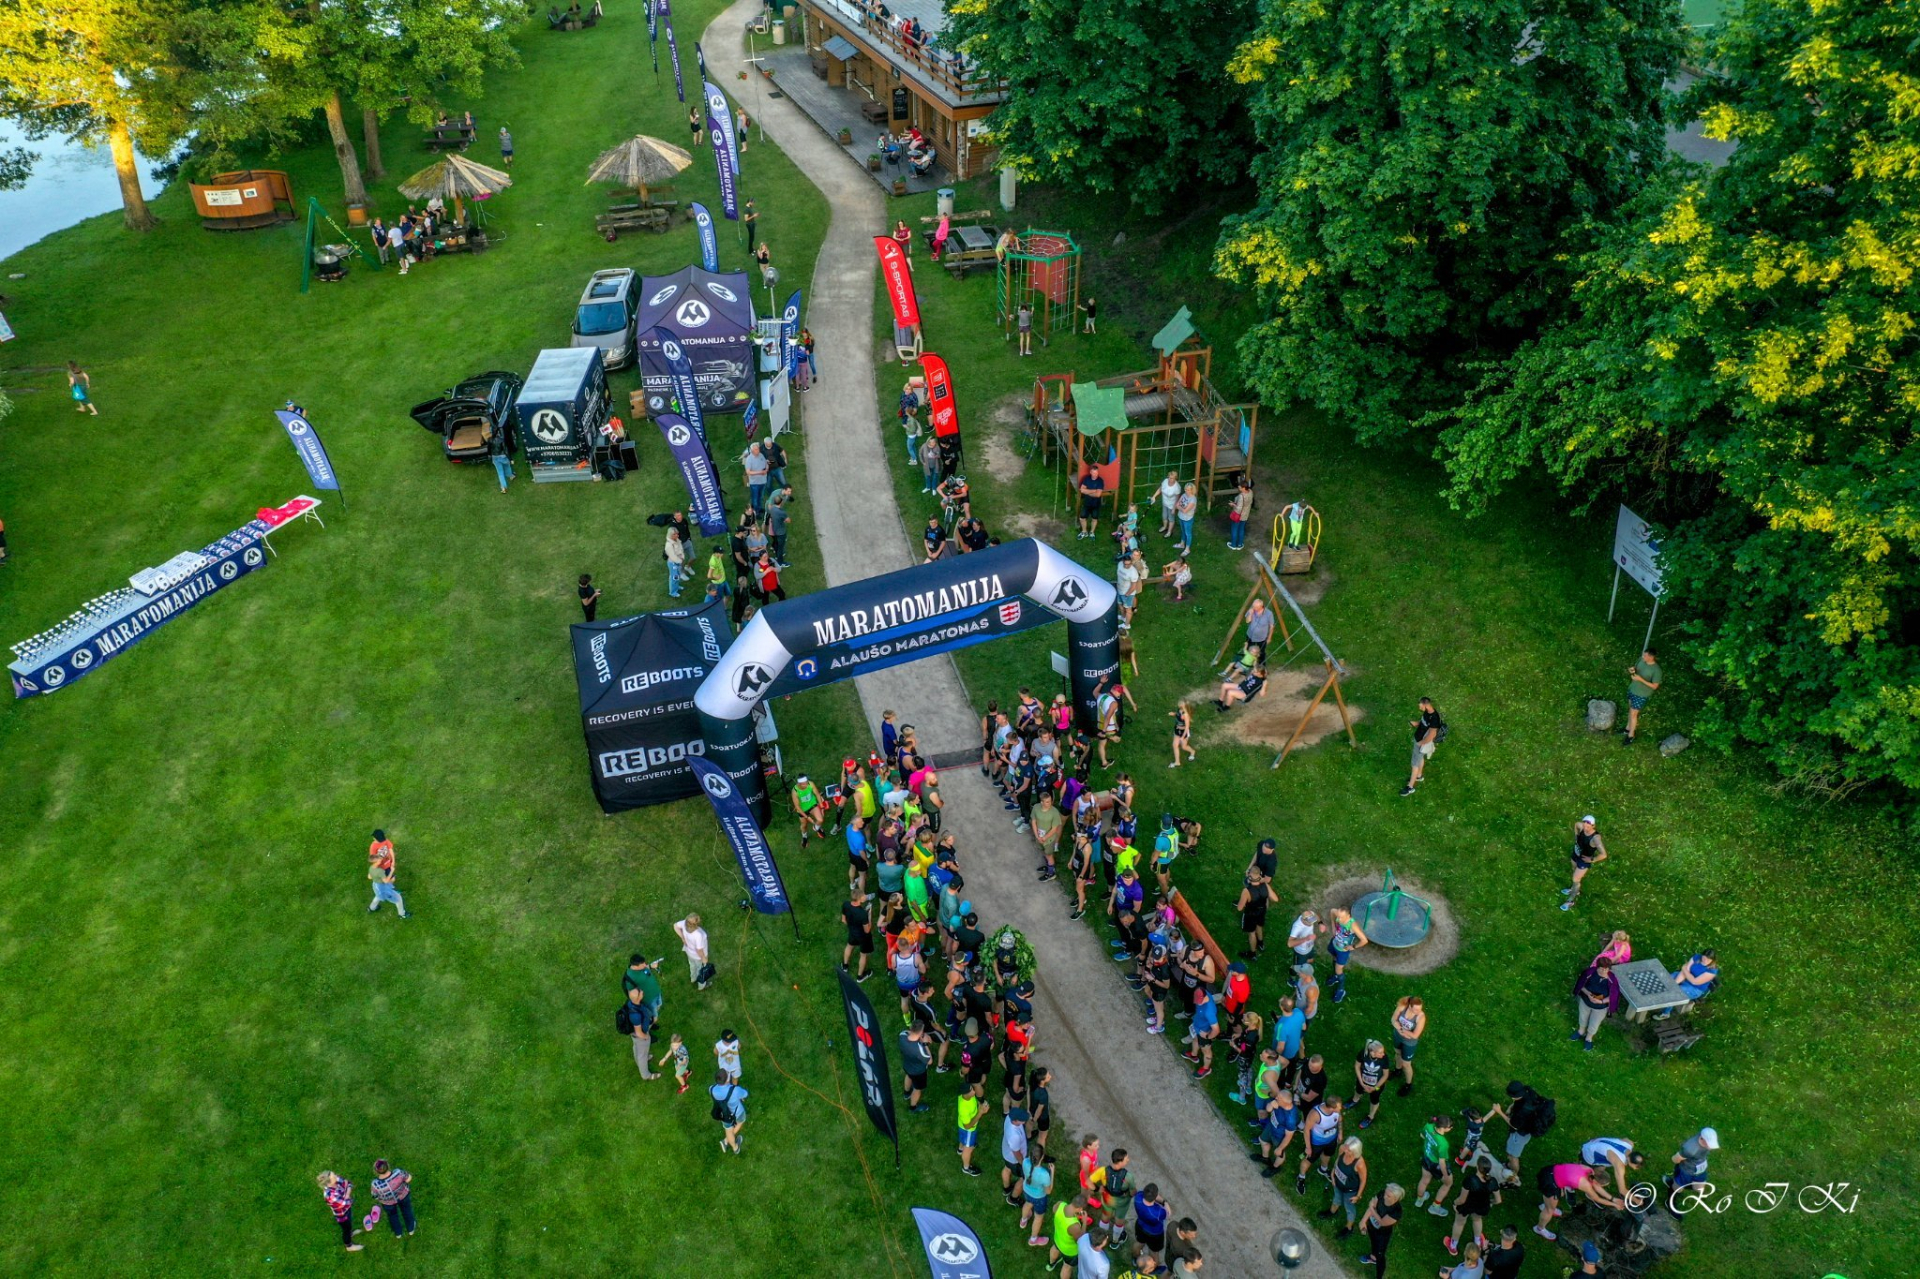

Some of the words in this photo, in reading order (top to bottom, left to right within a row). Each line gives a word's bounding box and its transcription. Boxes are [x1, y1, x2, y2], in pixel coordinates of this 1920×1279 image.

[95, 572, 217, 657] MARATOMANIJA
[812, 574, 1005, 647] MARATOMANIJA
[590, 632, 611, 684] REBOOTS
[697, 617, 721, 661] REBOOTS
[829, 642, 892, 670] ALAUŠO
[895, 617, 989, 651] MARATONAS
[621, 666, 704, 694] REBOOTS
[589, 708, 650, 725] RECOVERY
[653, 705, 664, 715] IS
[599, 739, 706, 778] REBOO
[624, 769, 672, 784] RECOVERY
[674, 766, 682, 775] IS
[726, 761, 758, 780] BOOTS
